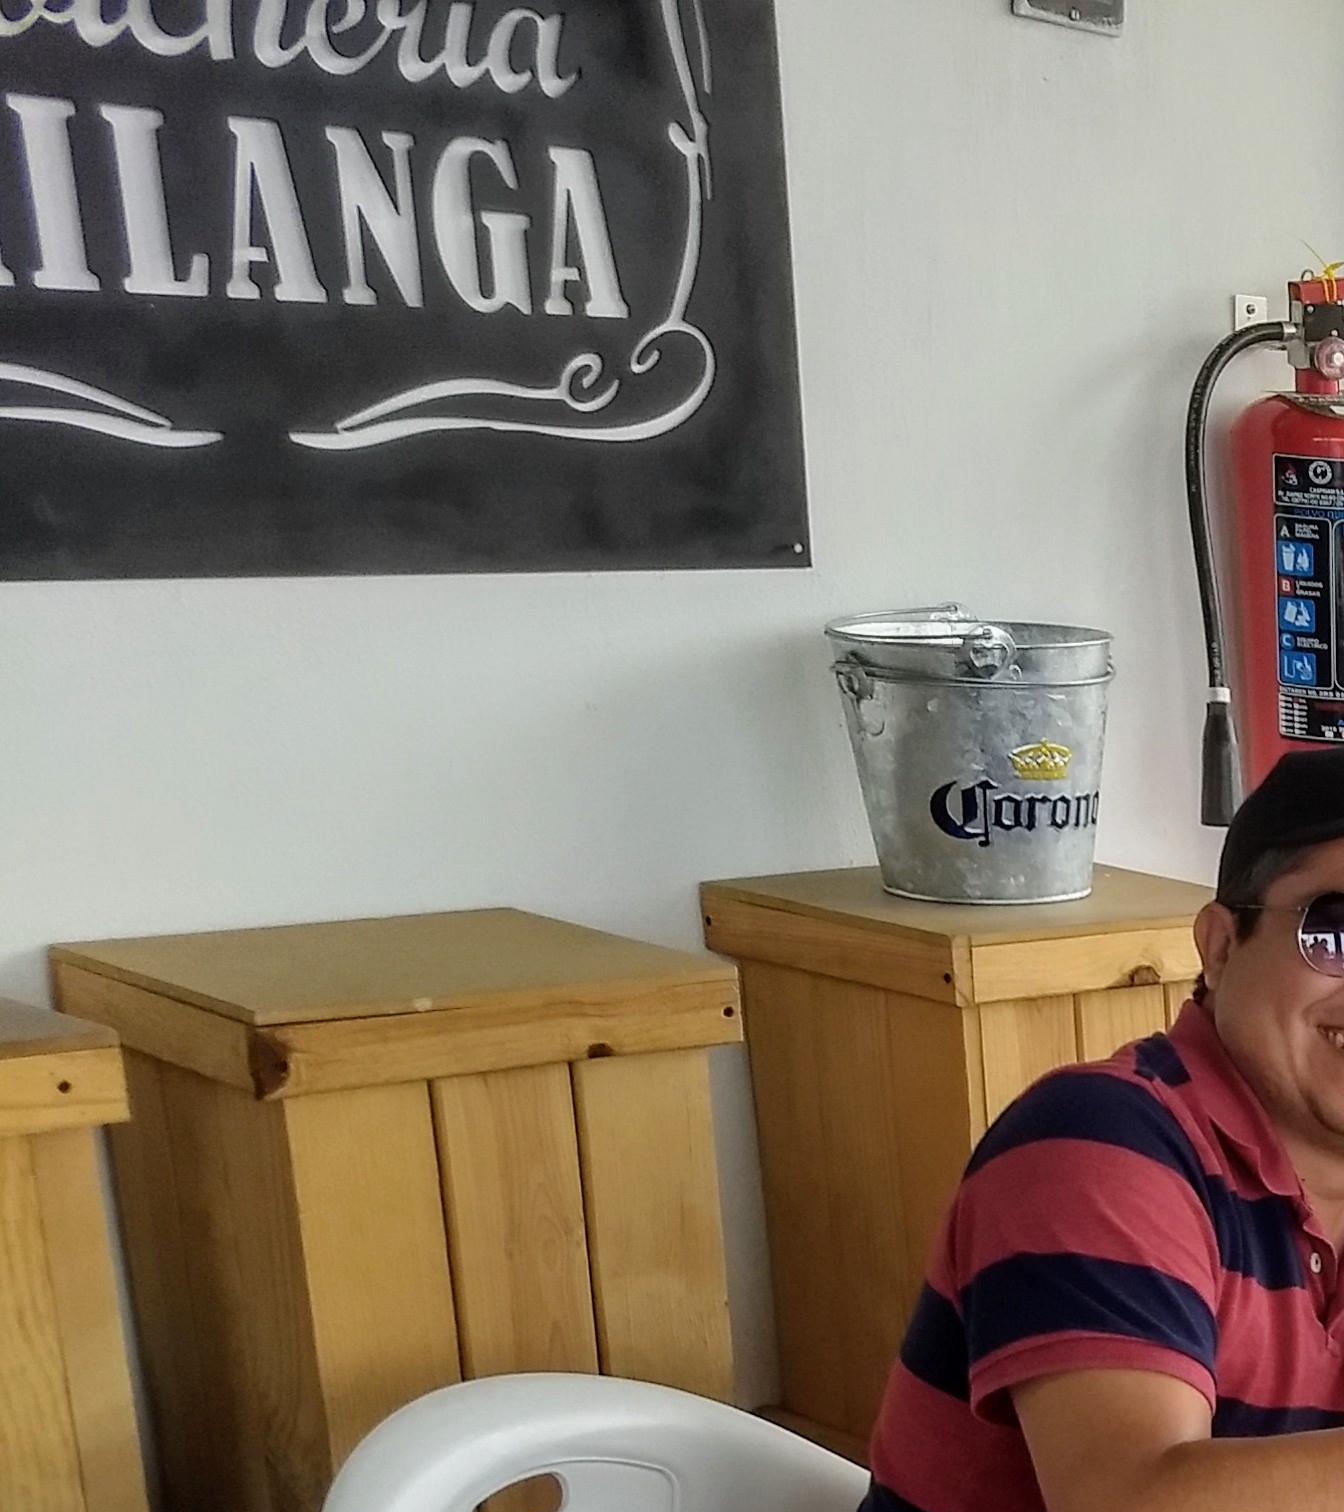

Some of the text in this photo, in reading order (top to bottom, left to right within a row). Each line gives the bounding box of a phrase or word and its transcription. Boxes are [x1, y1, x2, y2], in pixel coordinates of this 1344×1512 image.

[0, 93, 629, 318] ILANGA
[1280, 525, 1290, 538] A
[1282, 579, 1291, 592] B
[1282, 635, 1291, 647] C
